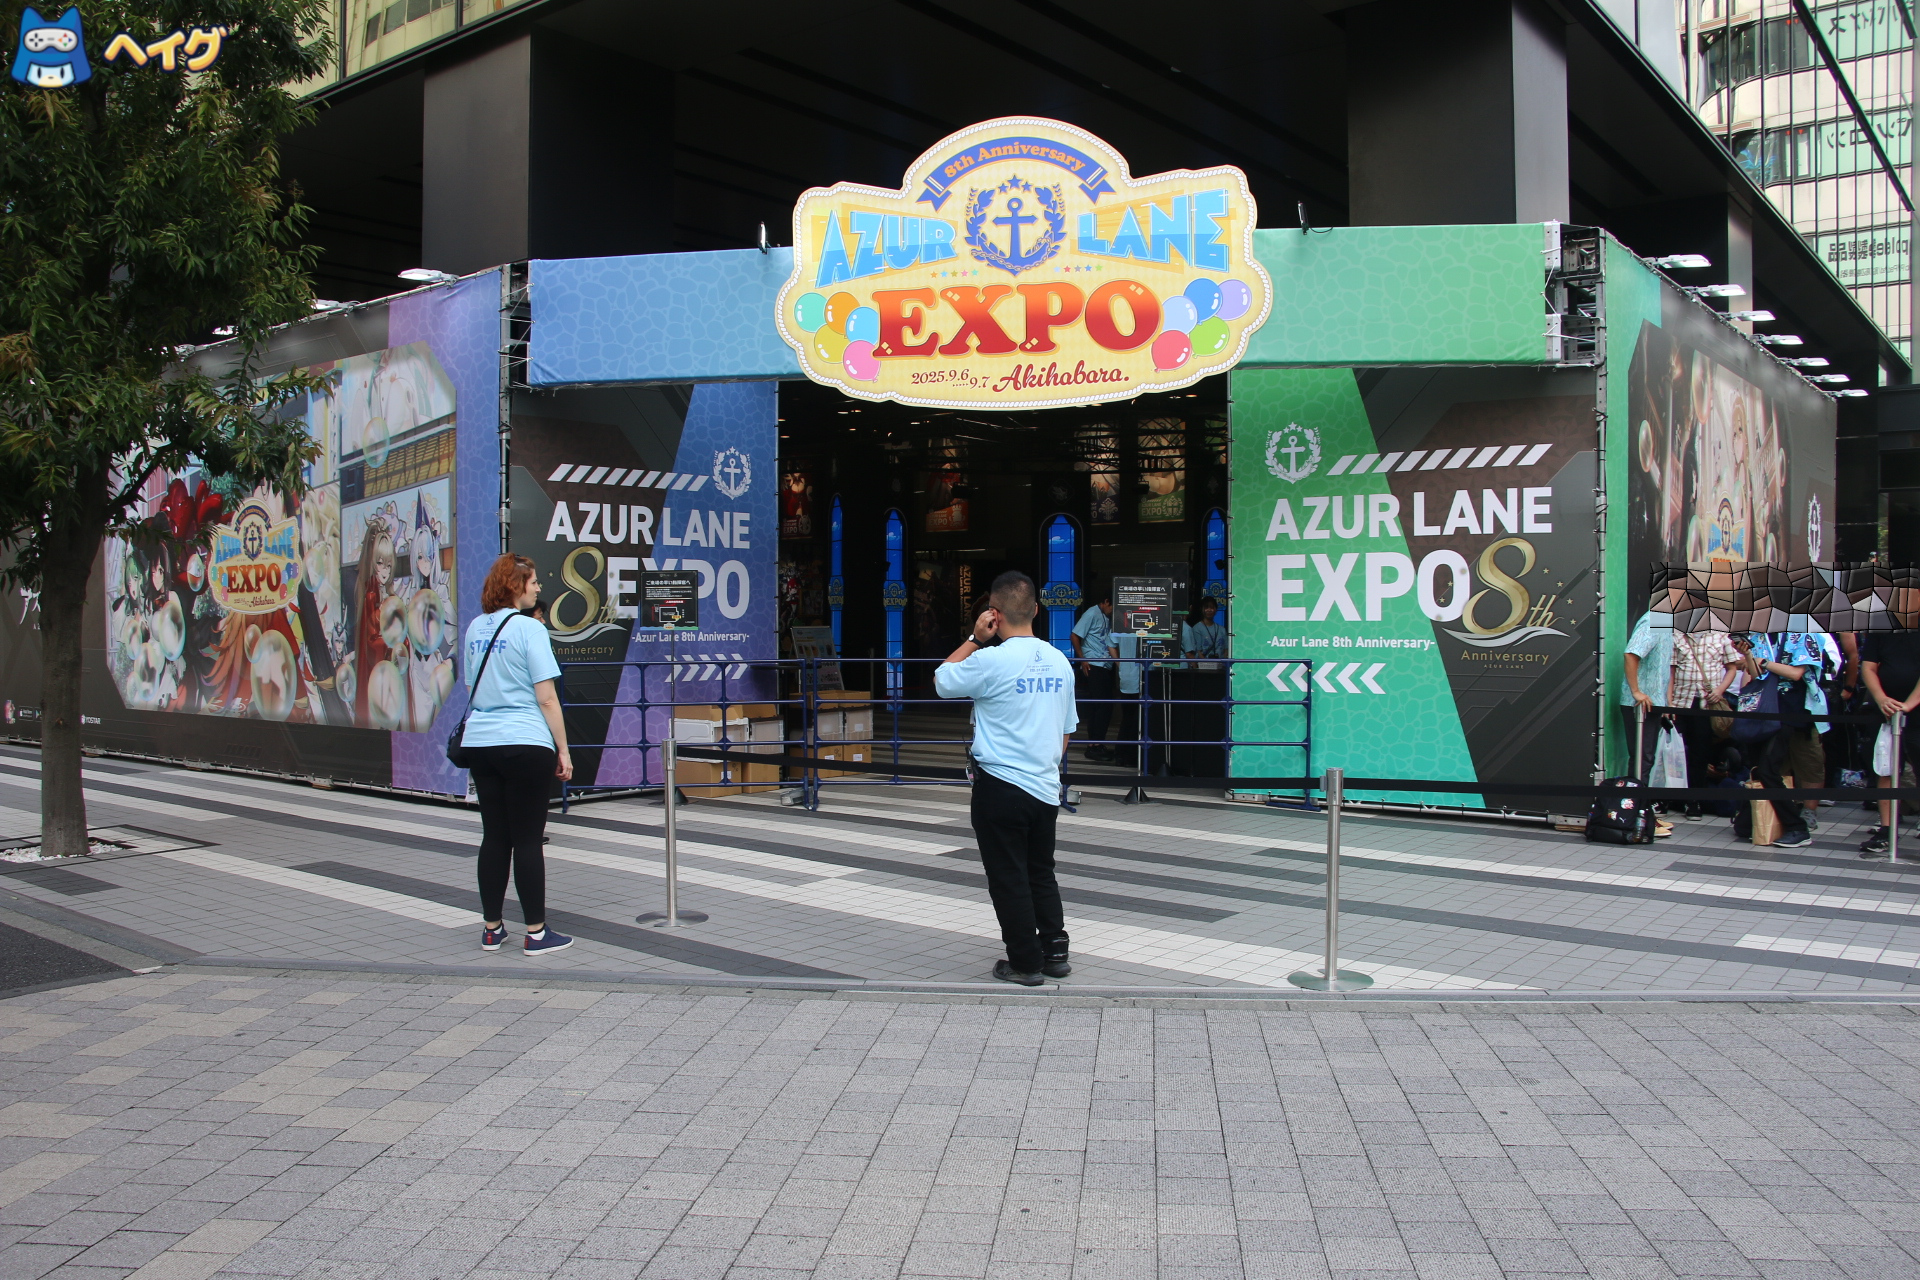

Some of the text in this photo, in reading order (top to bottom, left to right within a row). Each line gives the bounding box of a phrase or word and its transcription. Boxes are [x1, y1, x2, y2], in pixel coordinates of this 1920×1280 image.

[943, 140, 1087, 180] 8th Anniversary
[814, 188, 1230, 288] AZUR LANE
[871, 279, 1162, 358] EXPO
[911, 368, 970, 386] 2025.9.6
[992, 362, 1130, 393] Akihabara.
[546, 500, 751, 549] AZUR LANE
[1265, 486, 1552, 541] AZUR LANE
[264, 526, 295, 560] LANE
[226, 563, 281, 593] EXPO
[1267, 549, 1471, 622] EXPO
[681, 631, 696, 643] 8th
[1302, 636, 1329, 648] Lane
[1332, 636, 1353, 648] 8th
[1461, 650, 1550, 666] Anniversary
[1015, 677, 1063, 694] STAFF
